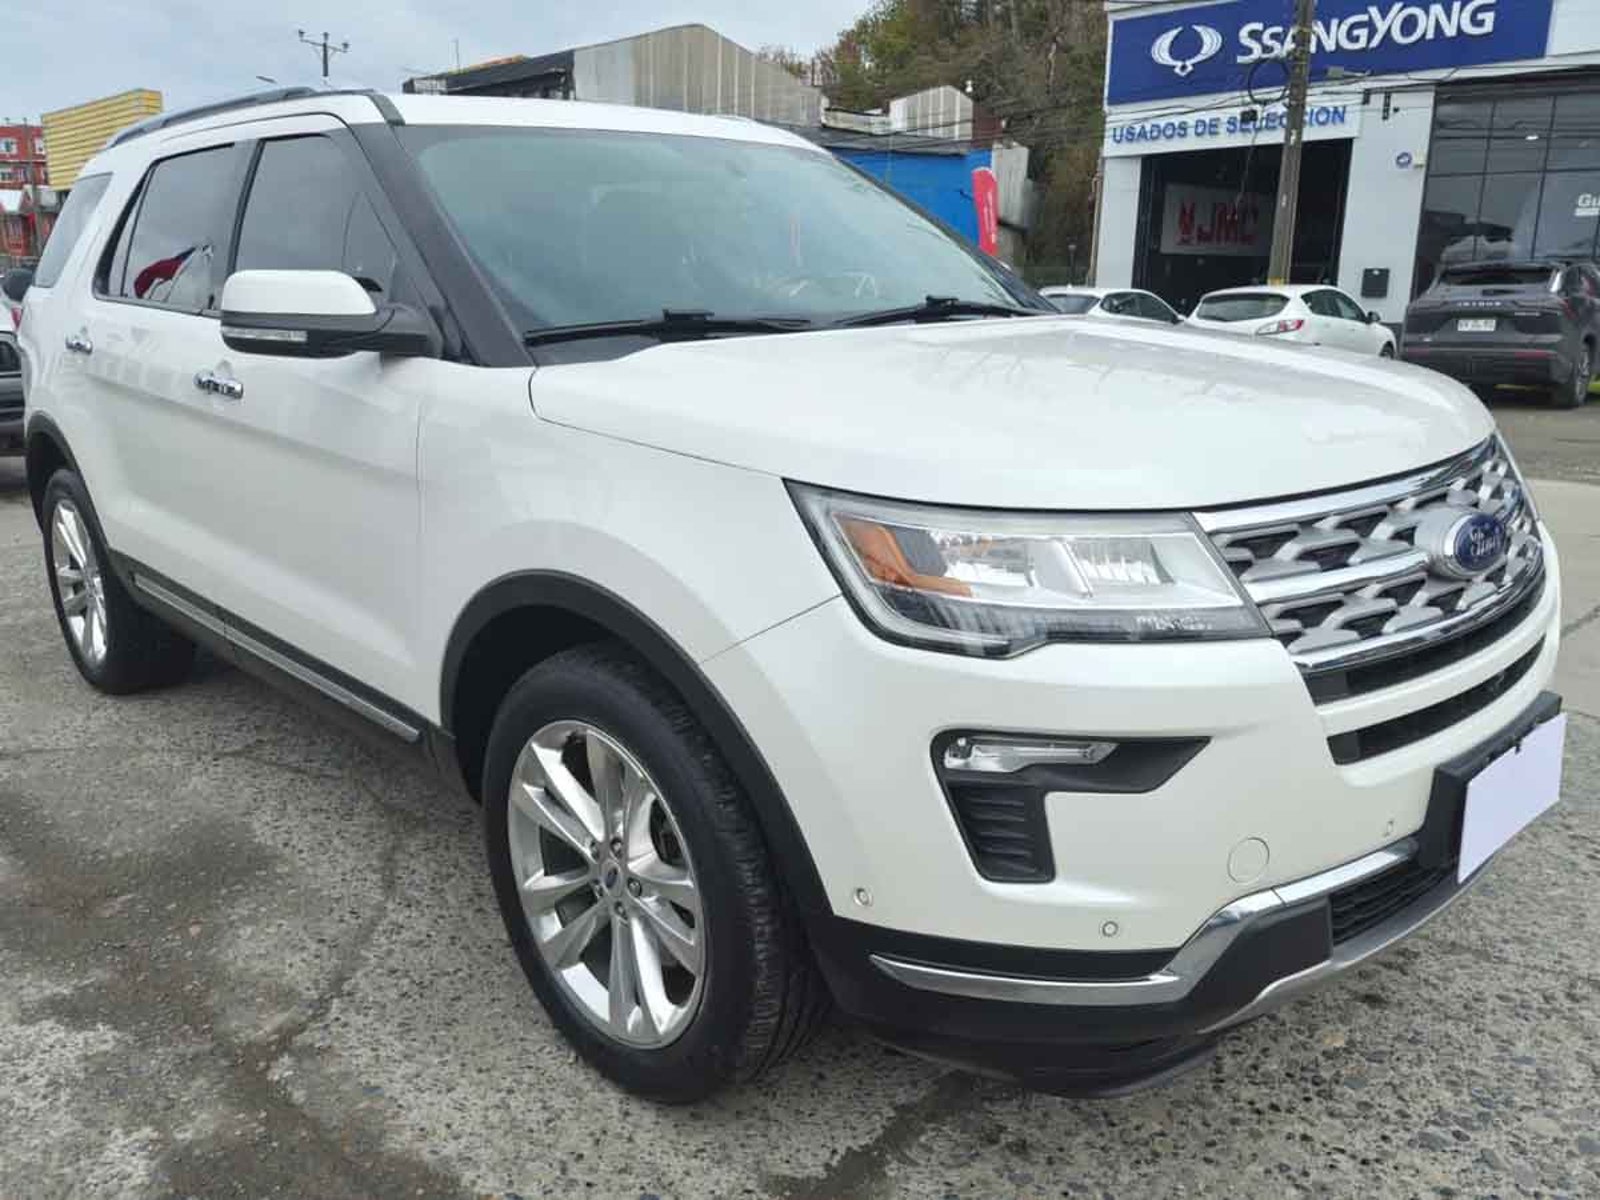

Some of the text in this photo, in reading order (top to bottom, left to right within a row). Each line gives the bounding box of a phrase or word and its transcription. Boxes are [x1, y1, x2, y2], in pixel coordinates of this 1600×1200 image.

[1112, 105, 1346, 143] USADOS DE SLEION
